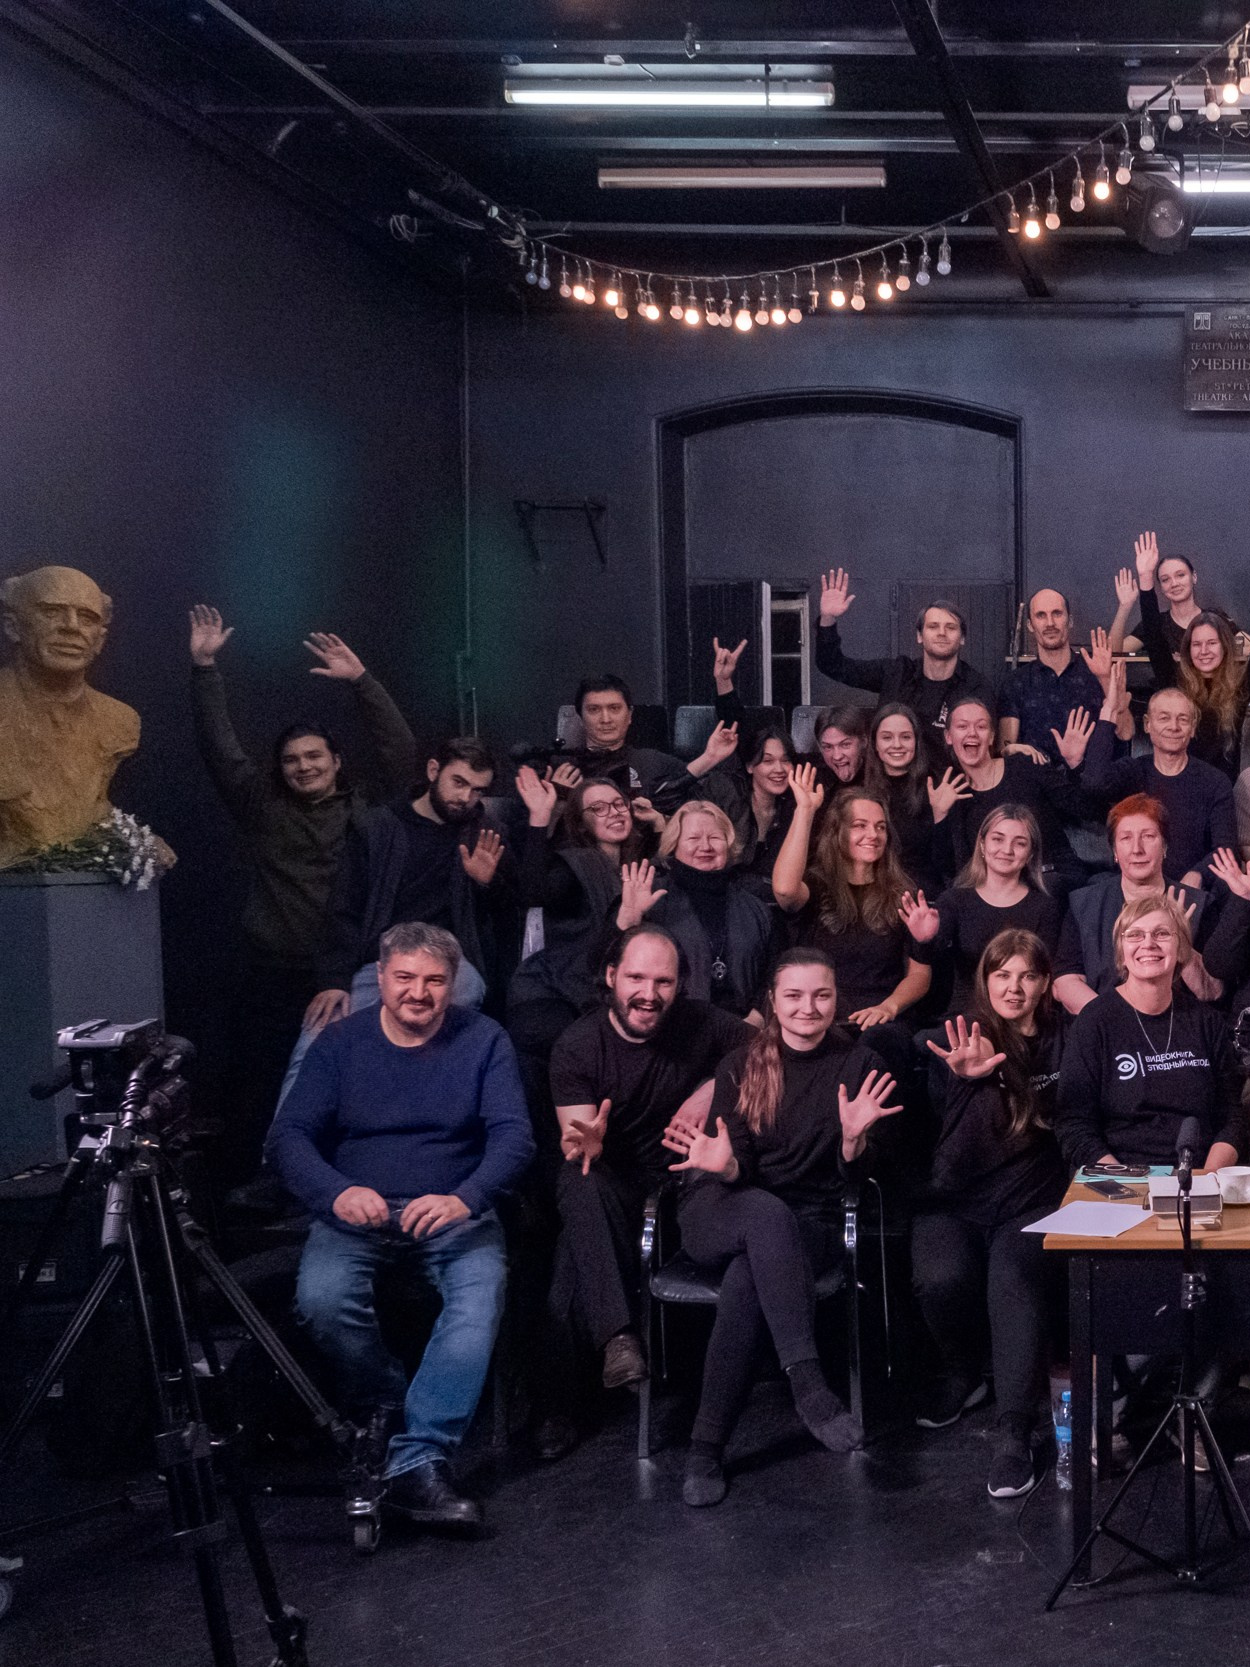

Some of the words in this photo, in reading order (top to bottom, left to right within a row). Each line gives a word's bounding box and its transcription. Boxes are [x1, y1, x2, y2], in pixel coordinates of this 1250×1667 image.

[1193, 393, 1234, 401] THEATRE
[1145, 1051, 1196, 1063] ВИДЕОКНИГА
[1147, 1058, 1187, 1071] ЭТЮДНЫЙ
[1187, 1059, 1210, 1068] МЕТОД
